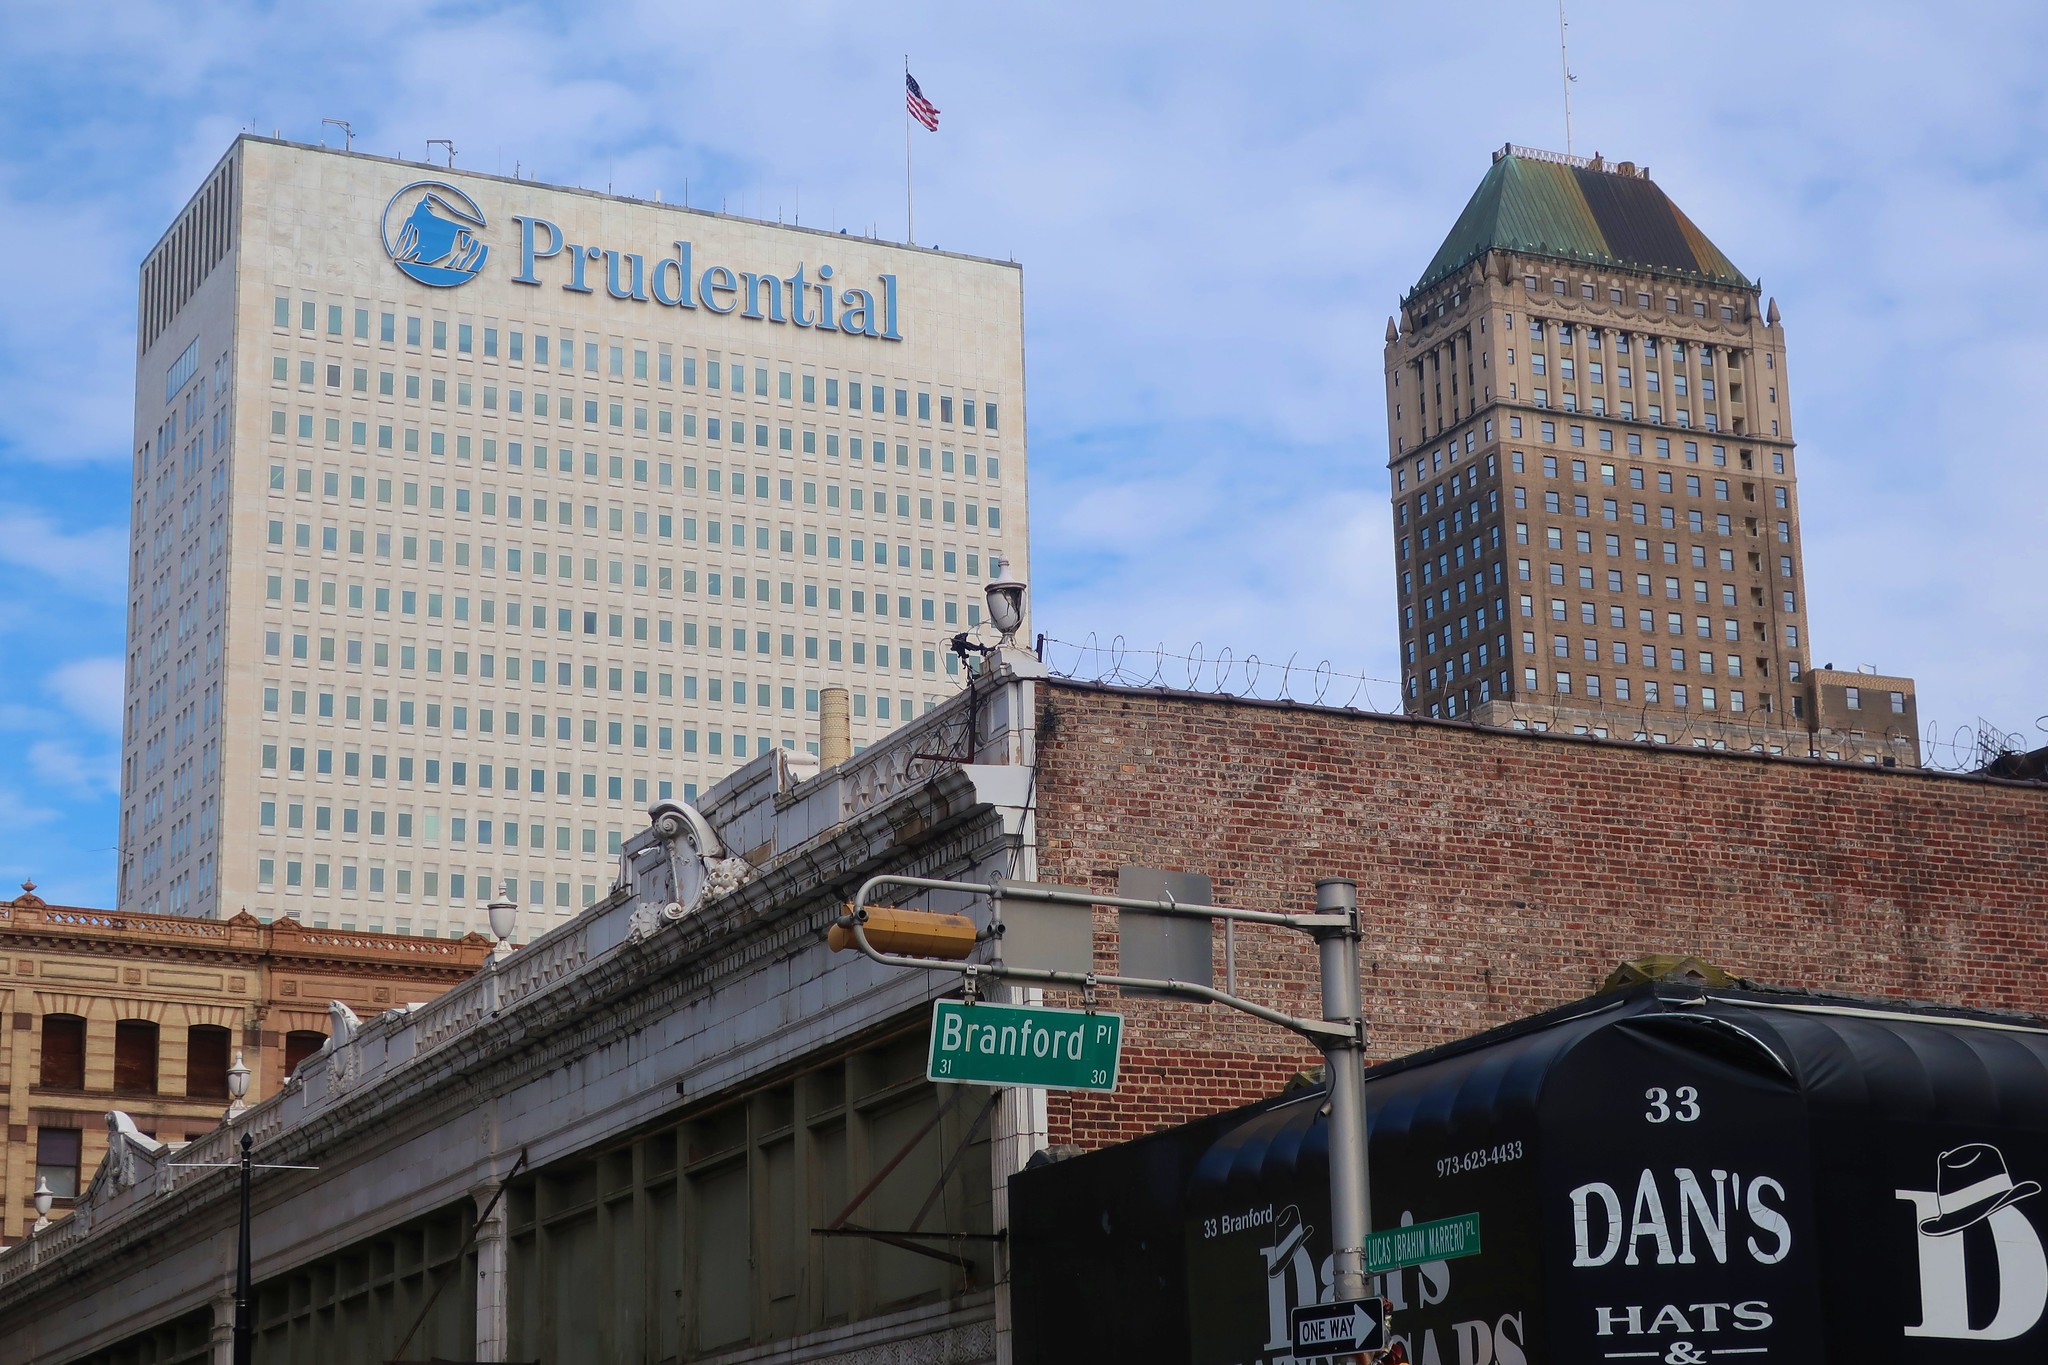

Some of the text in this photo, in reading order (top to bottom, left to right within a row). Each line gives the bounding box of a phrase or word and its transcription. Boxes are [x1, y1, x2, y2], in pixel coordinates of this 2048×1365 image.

[511, 214, 904, 341] Prudential
[941, 1012, 1085, 1061] Branford
[939, 1058, 952, 1074] 31
[1090, 1069, 1107, 1085] 30
[1645, 1086, 1701, 1123] 33
[1436, 1140, 1524, 1178] 973-623-4433
[1204, 1203, 1274, 1239] 33 Branford
[1569, 1168, 1792, 1268] DAN'S
[1368, 1220, 1476, 1267] LUCAS IBRAHIM MARRERO PL
[1302, 1317, 1355, 1342] ONE WAY
[1595, 1301, 1774, 1336] HATS
